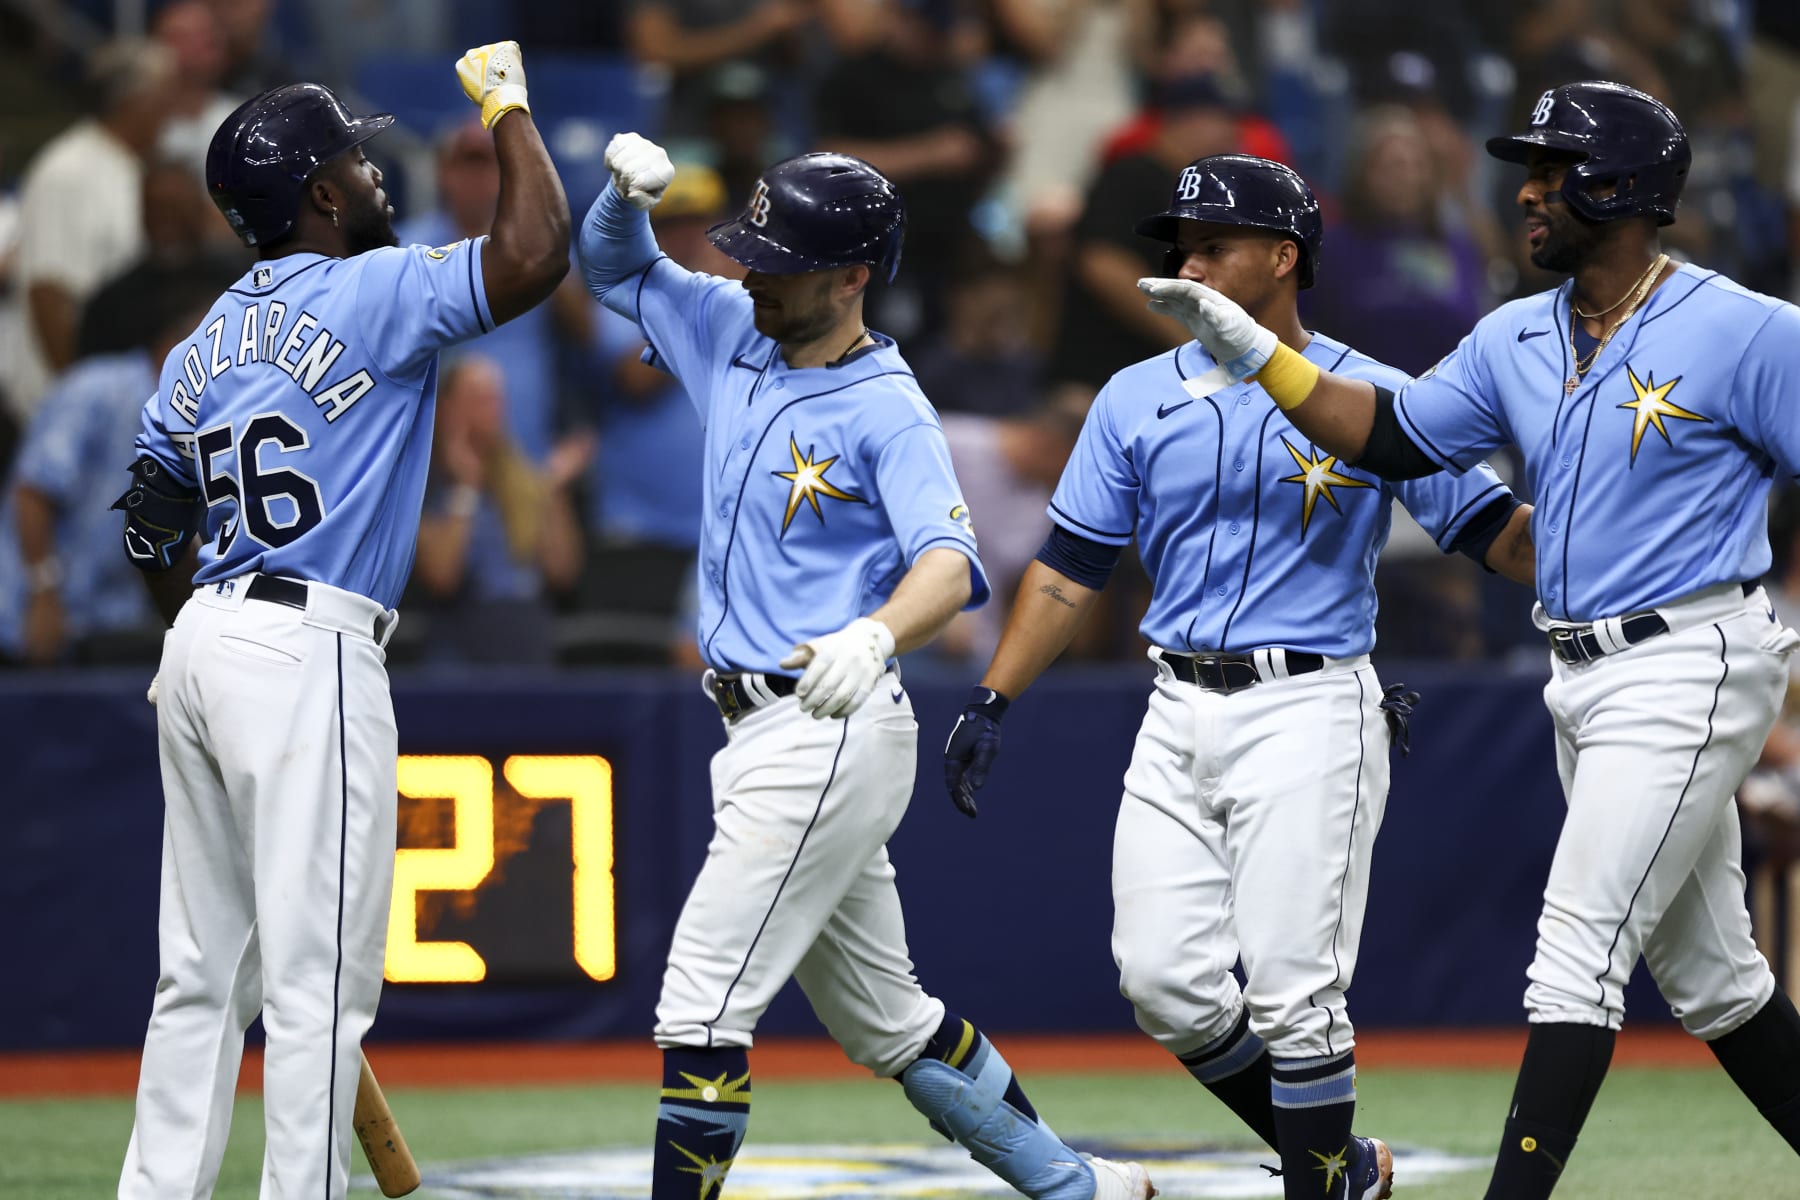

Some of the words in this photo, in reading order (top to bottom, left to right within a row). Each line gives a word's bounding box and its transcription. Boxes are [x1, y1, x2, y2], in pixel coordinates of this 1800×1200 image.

[1532, 89, 1555, 125] TB
[750, 178, 771, 228] TB
[1177, 165, 1202, 200] TB
[195, 410, 327, 560] 56
[384, 755, 616, 983] 27
